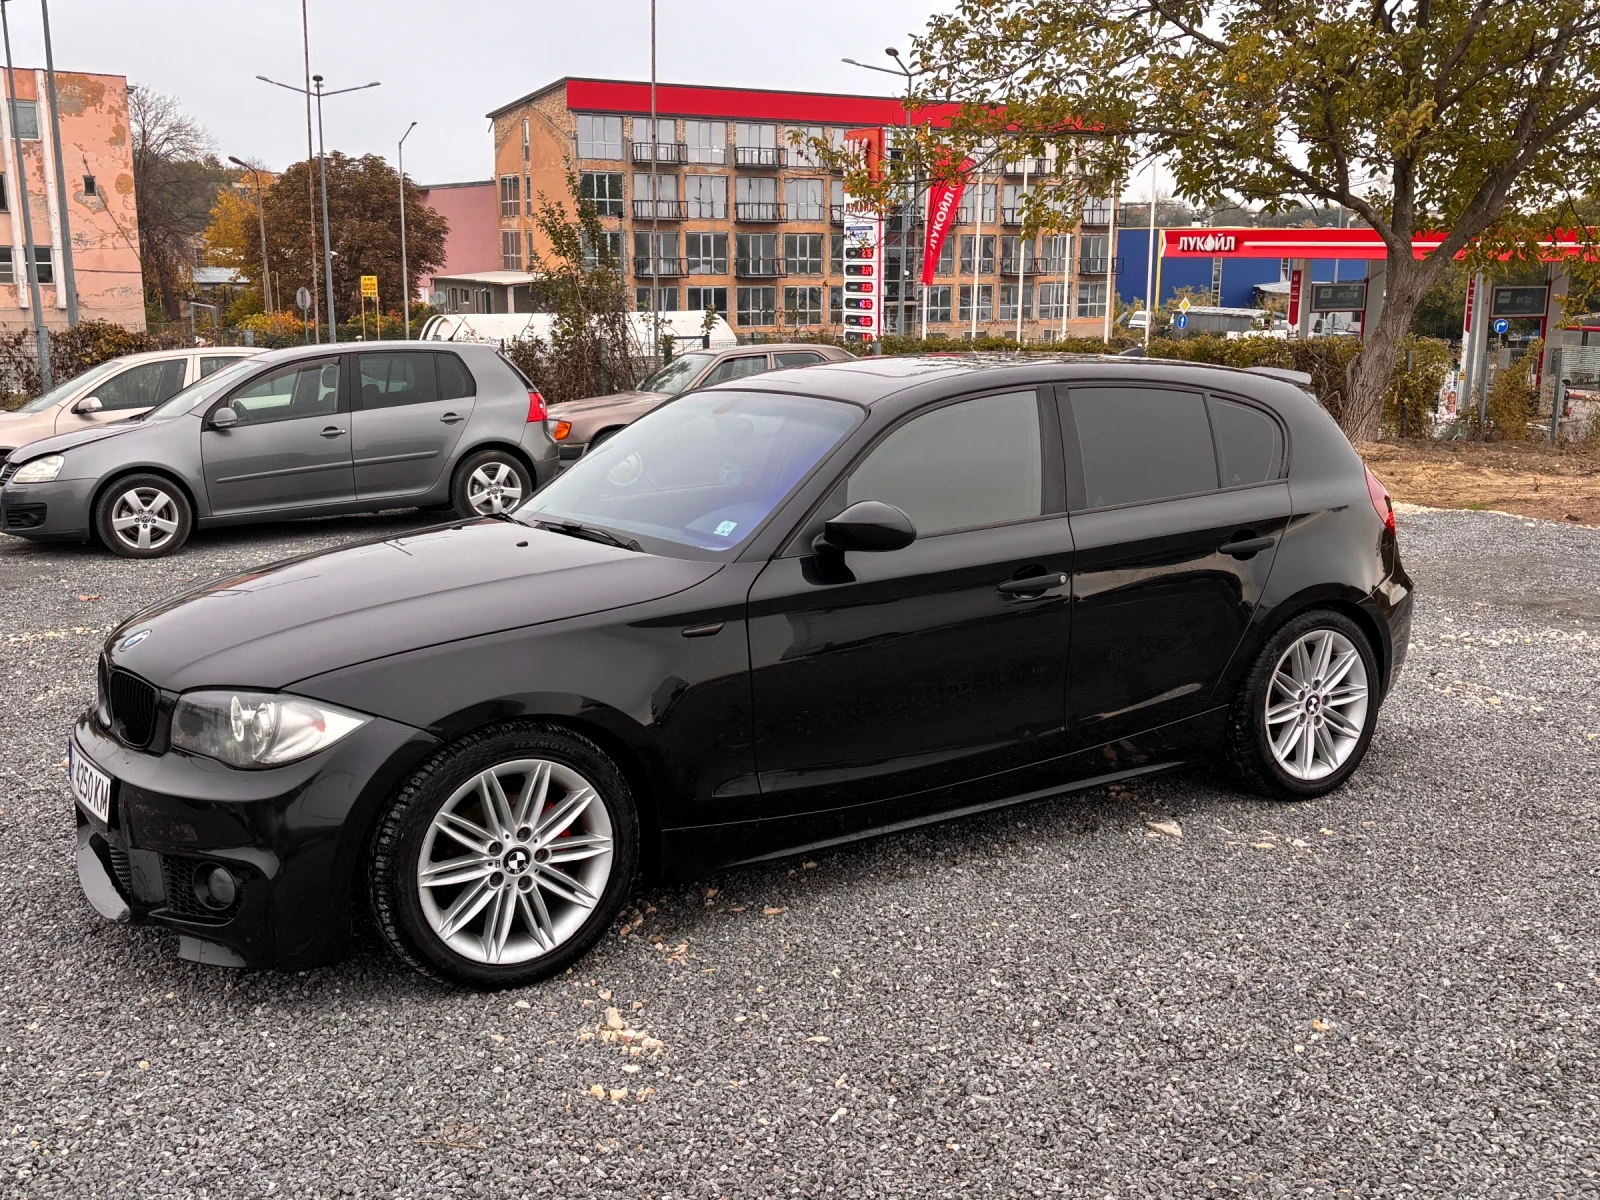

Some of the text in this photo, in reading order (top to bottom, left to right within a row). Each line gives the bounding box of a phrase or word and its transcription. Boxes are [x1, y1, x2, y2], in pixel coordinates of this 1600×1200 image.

[929, 191, 955, 250] ЛУКОЙЛ
[1178, 233, 1236, 251] ЛУКОЙЛ
[76, 759, 94, 804] 4250
[93, 775, 109, 818] KM
